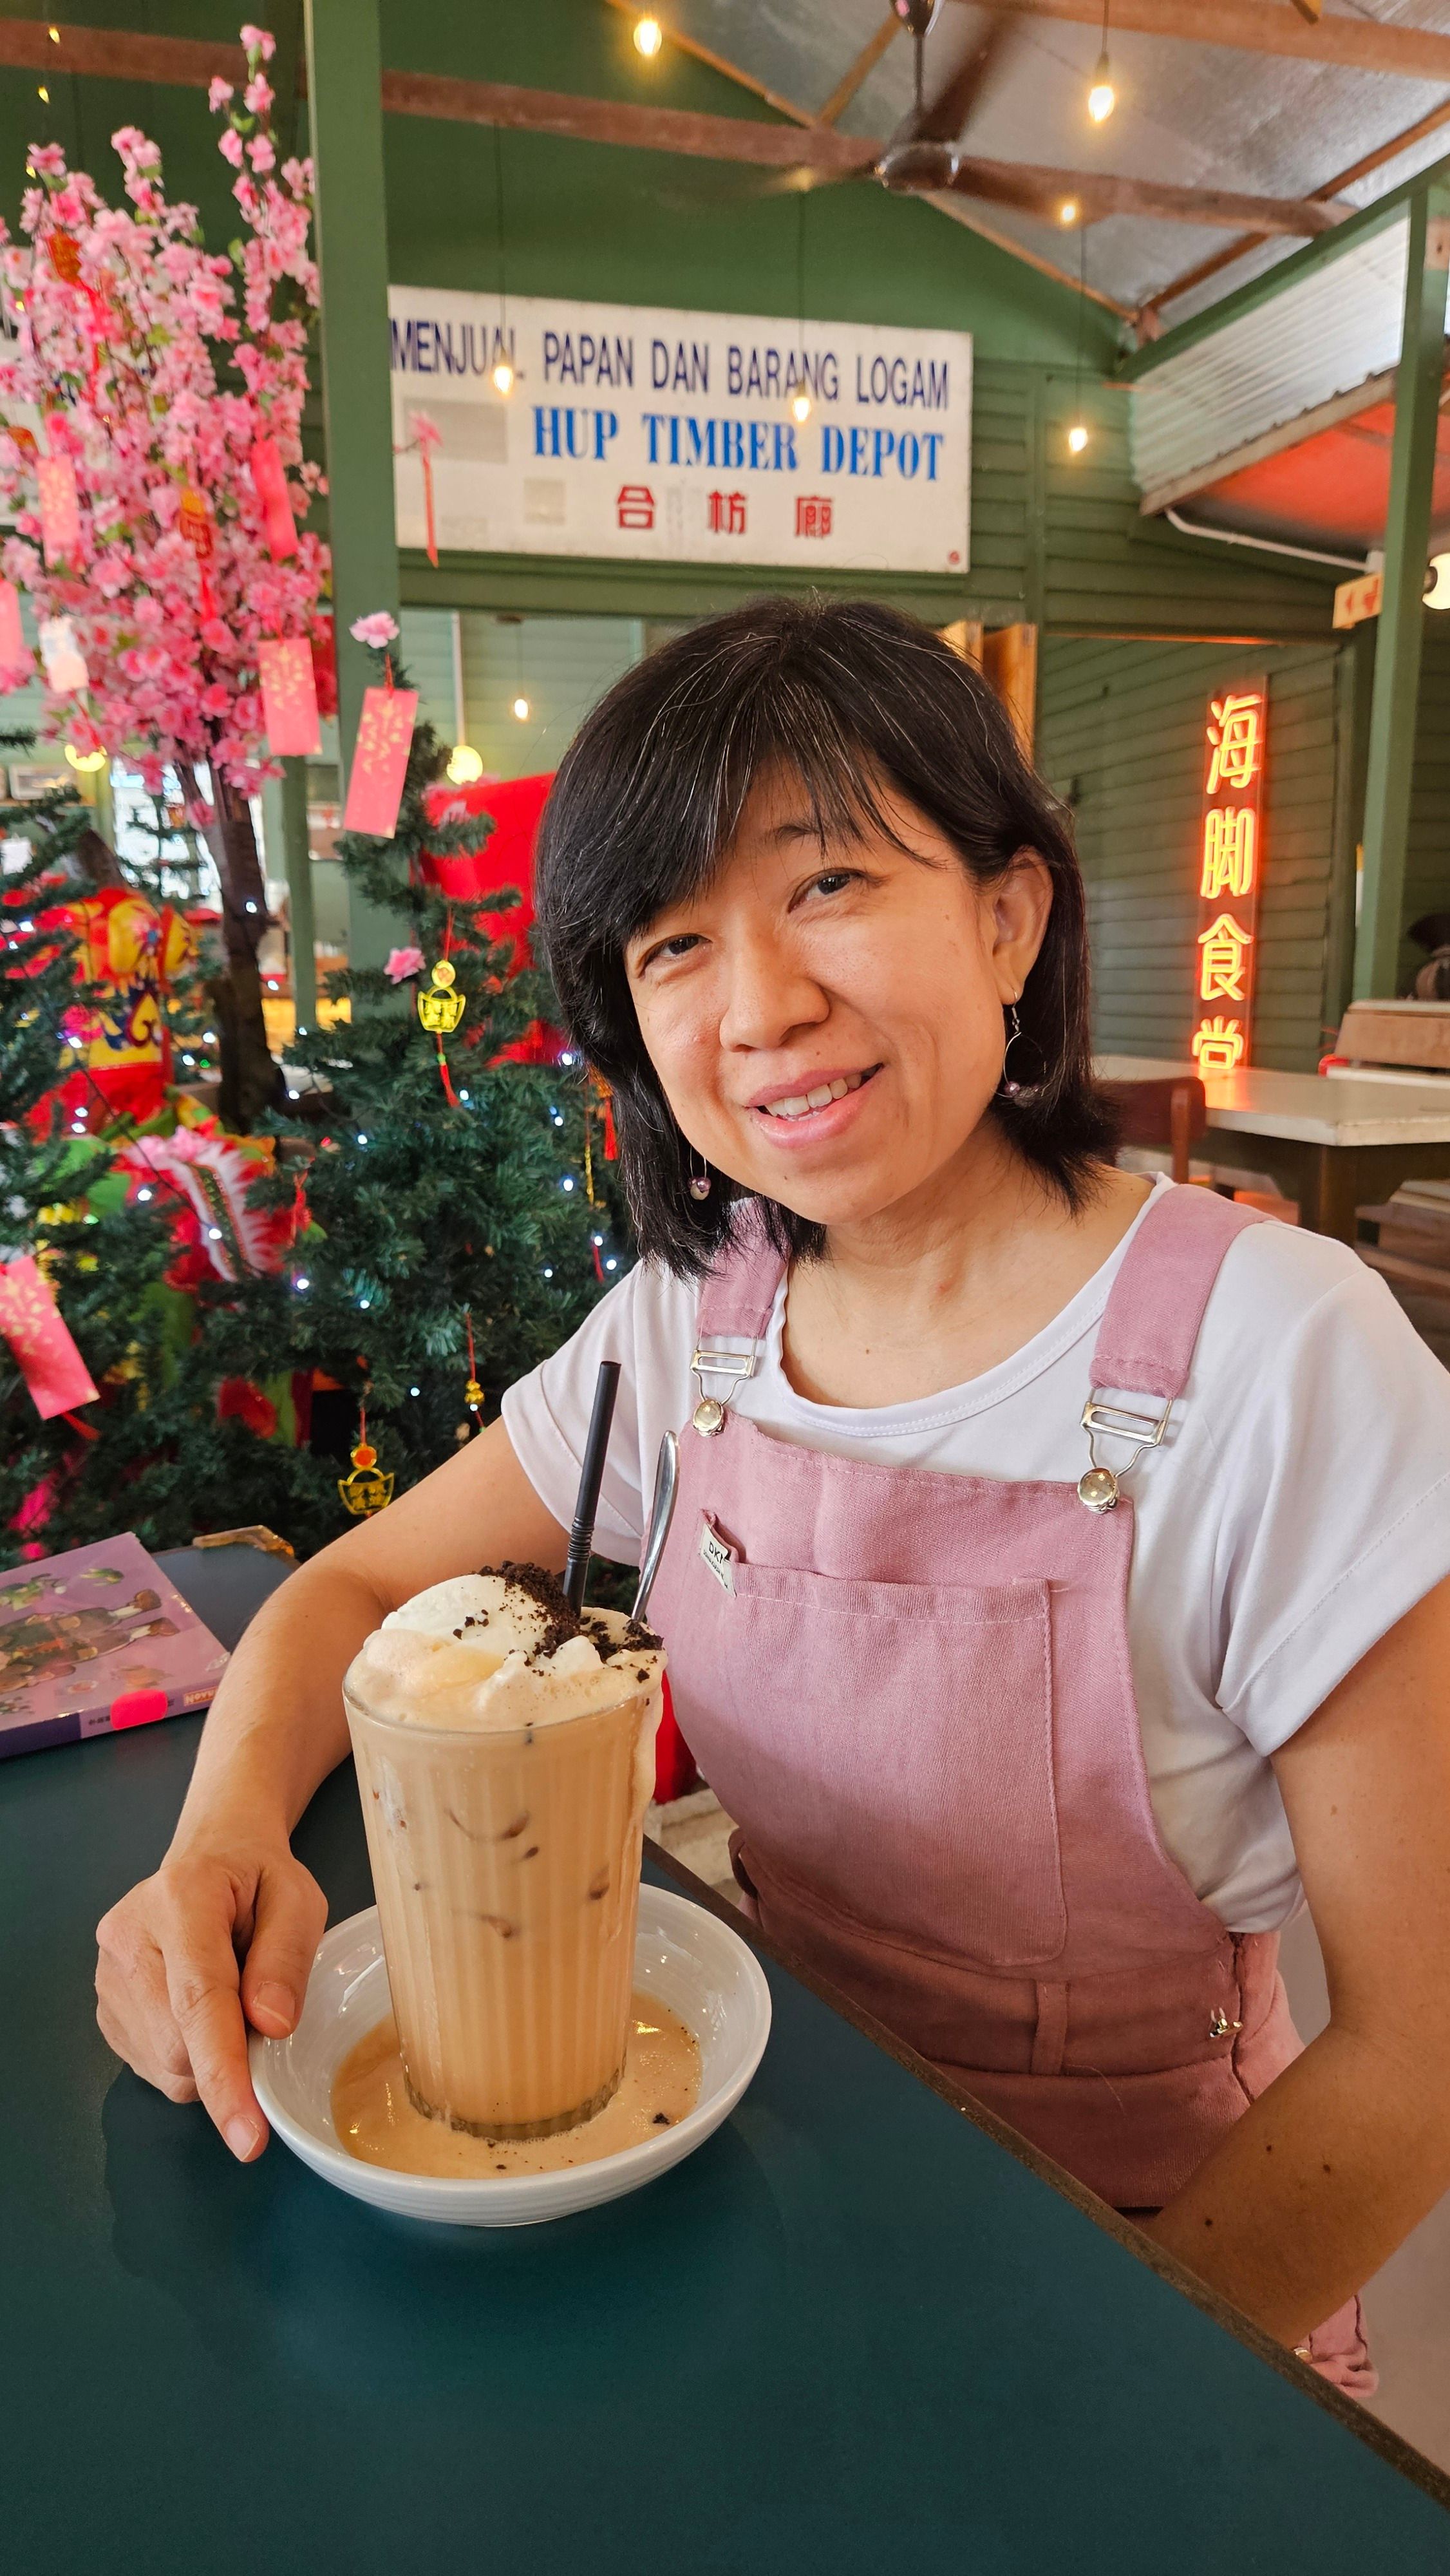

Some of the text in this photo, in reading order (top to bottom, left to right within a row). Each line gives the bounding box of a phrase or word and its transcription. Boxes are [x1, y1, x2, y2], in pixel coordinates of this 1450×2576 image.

[390, 317, 950, 411] MENJUAL PAPAN DAN BARANG LOGAM
[533, 406, 944, 482] HUP TIMBER DEPOT
